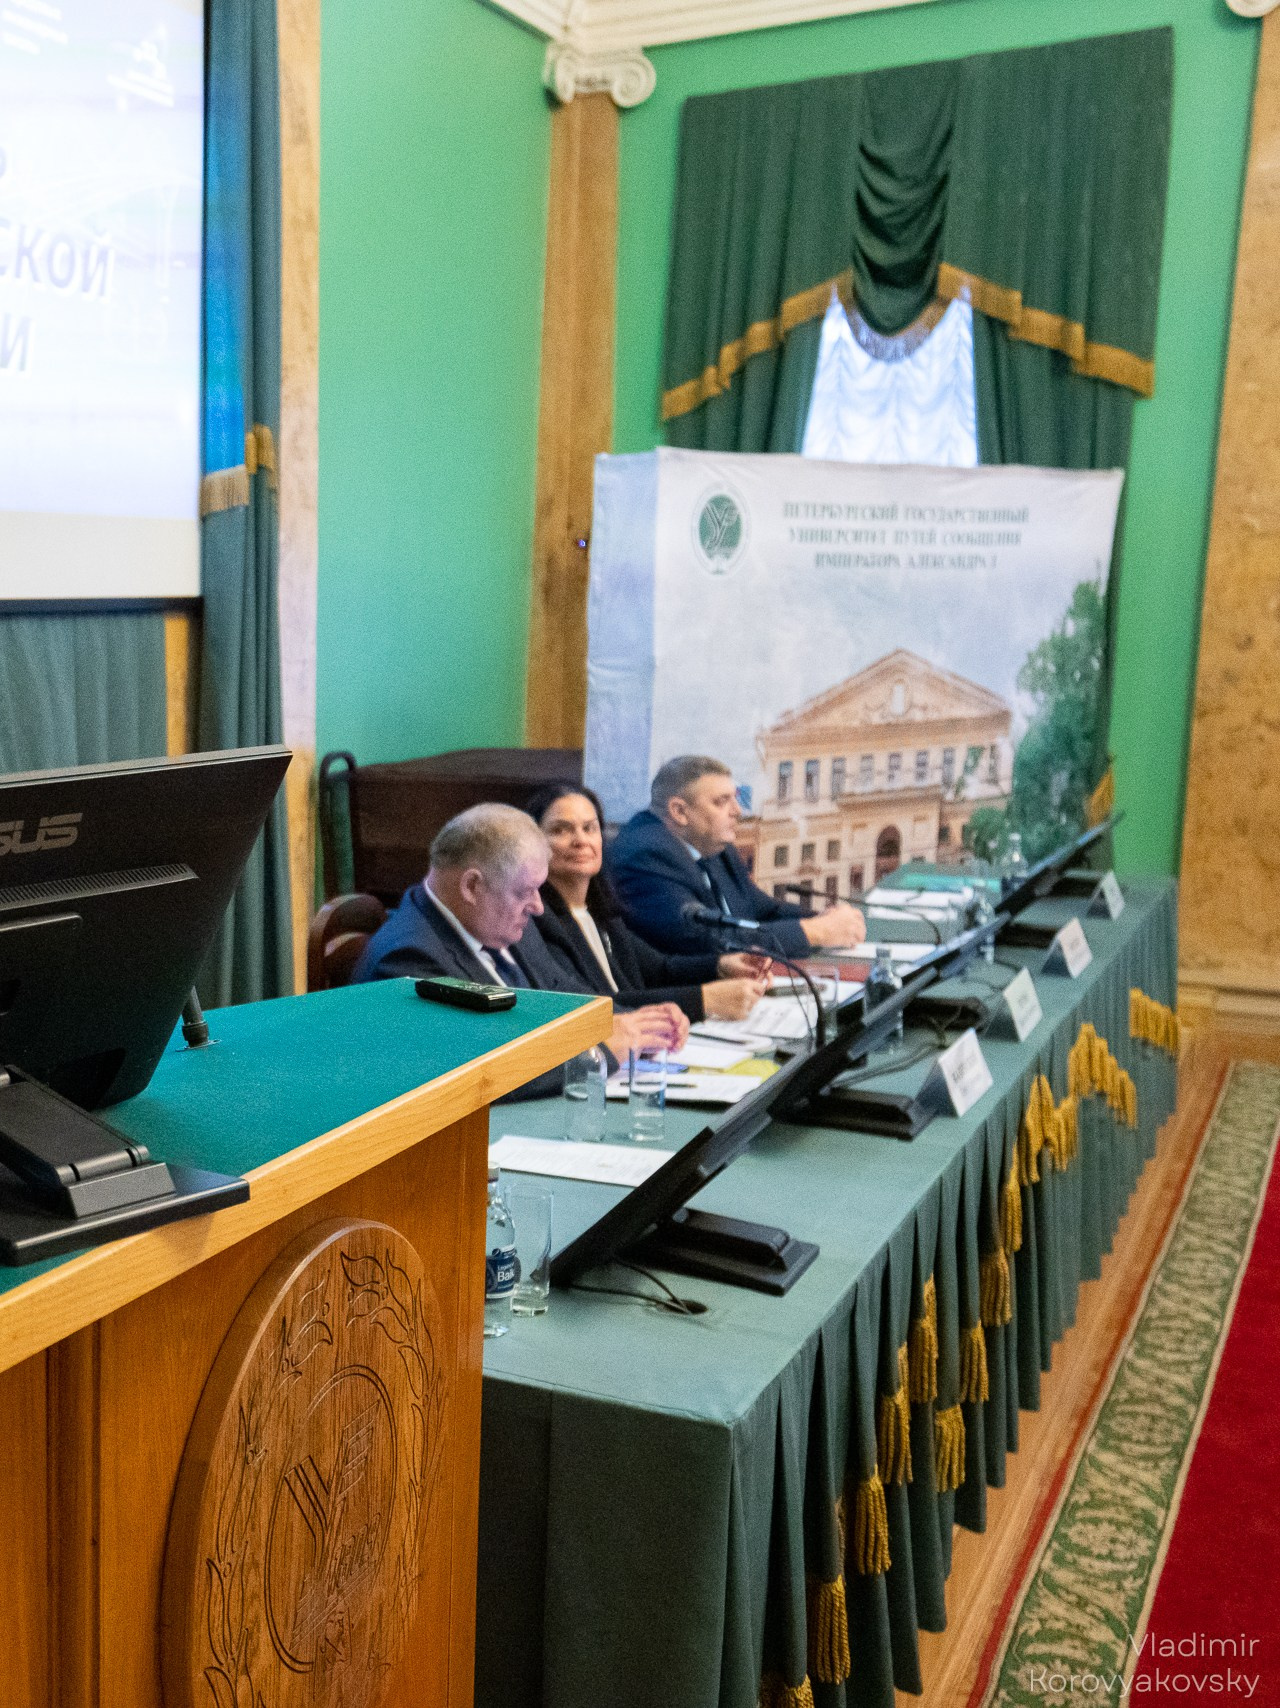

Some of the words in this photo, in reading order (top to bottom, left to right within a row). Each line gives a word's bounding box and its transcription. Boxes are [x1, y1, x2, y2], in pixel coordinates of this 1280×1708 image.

[783, 501, 899, 521] ПЕТЕРБУРГСКИЙ
[903, 505, 1030, 524] ГОСУДАРСТВЕННЫЙ
[789, 527, 887, 545] УНИВЕРСИТЕТ
[894, 528, 937, 546] ПУТЕЙ
[814, 552, 901, 569] ИМПЕРАТОРА
[908, 552, 988, 570] АЛЕКСАНДРА
